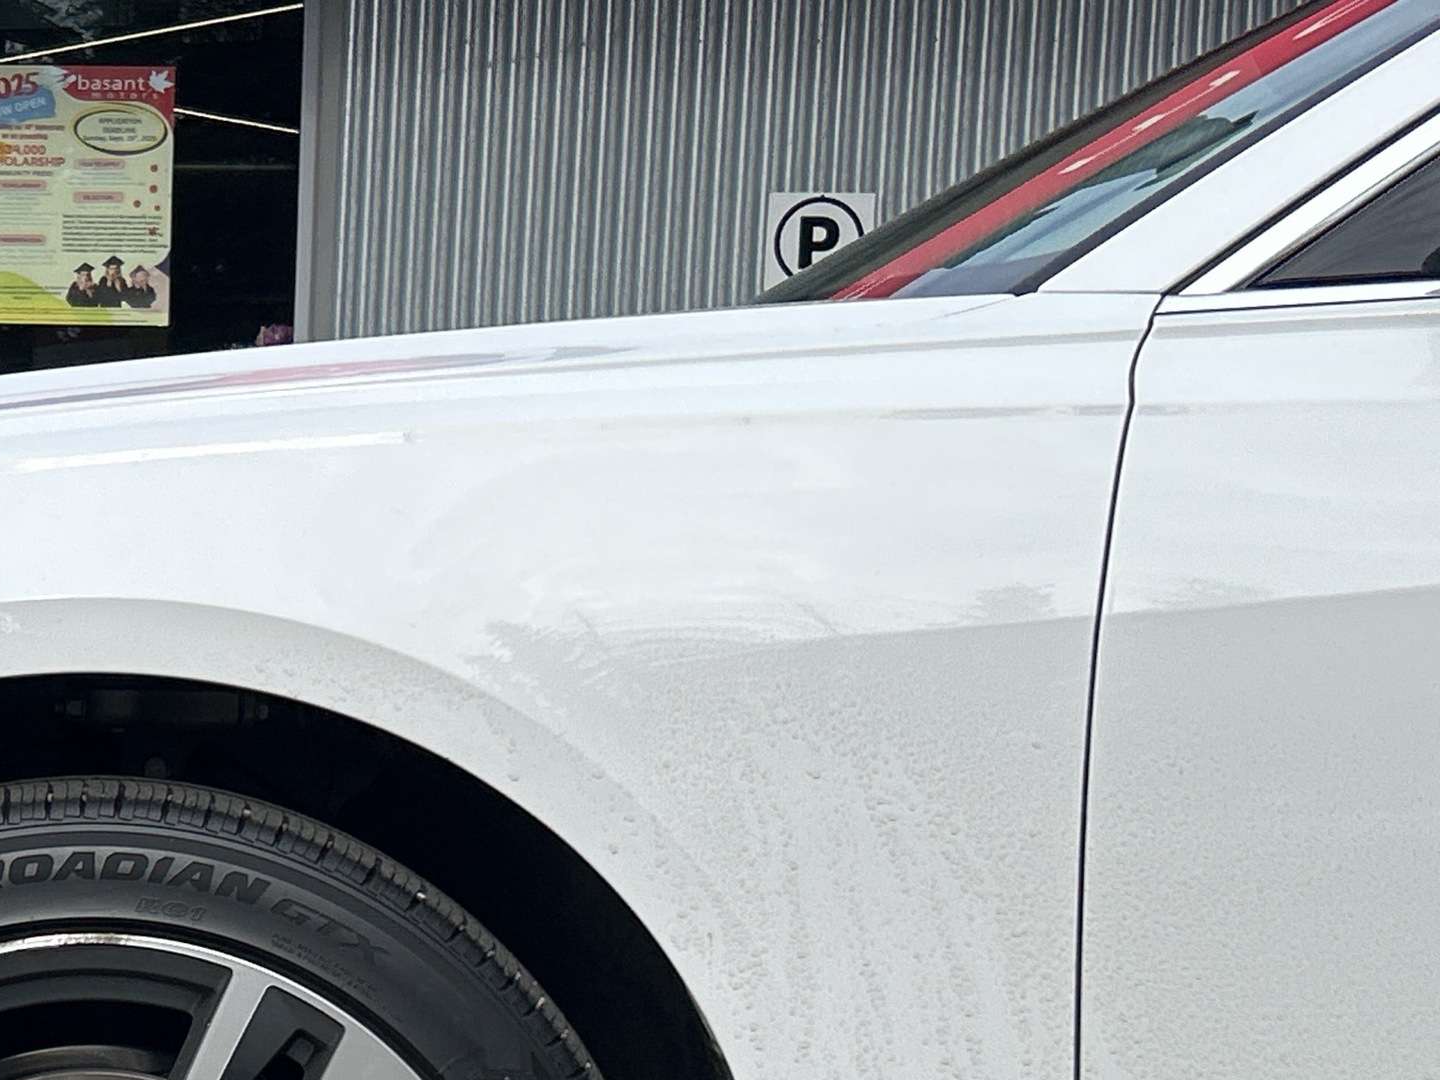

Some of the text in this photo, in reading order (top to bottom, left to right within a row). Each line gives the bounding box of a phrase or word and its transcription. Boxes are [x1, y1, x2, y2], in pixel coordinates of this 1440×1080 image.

[77, 74, 145, 91] basant
[14, 96, 46, 112] OPEN
[798, 216, 840, 269] P
[270, 898, 392, 966] GTX
